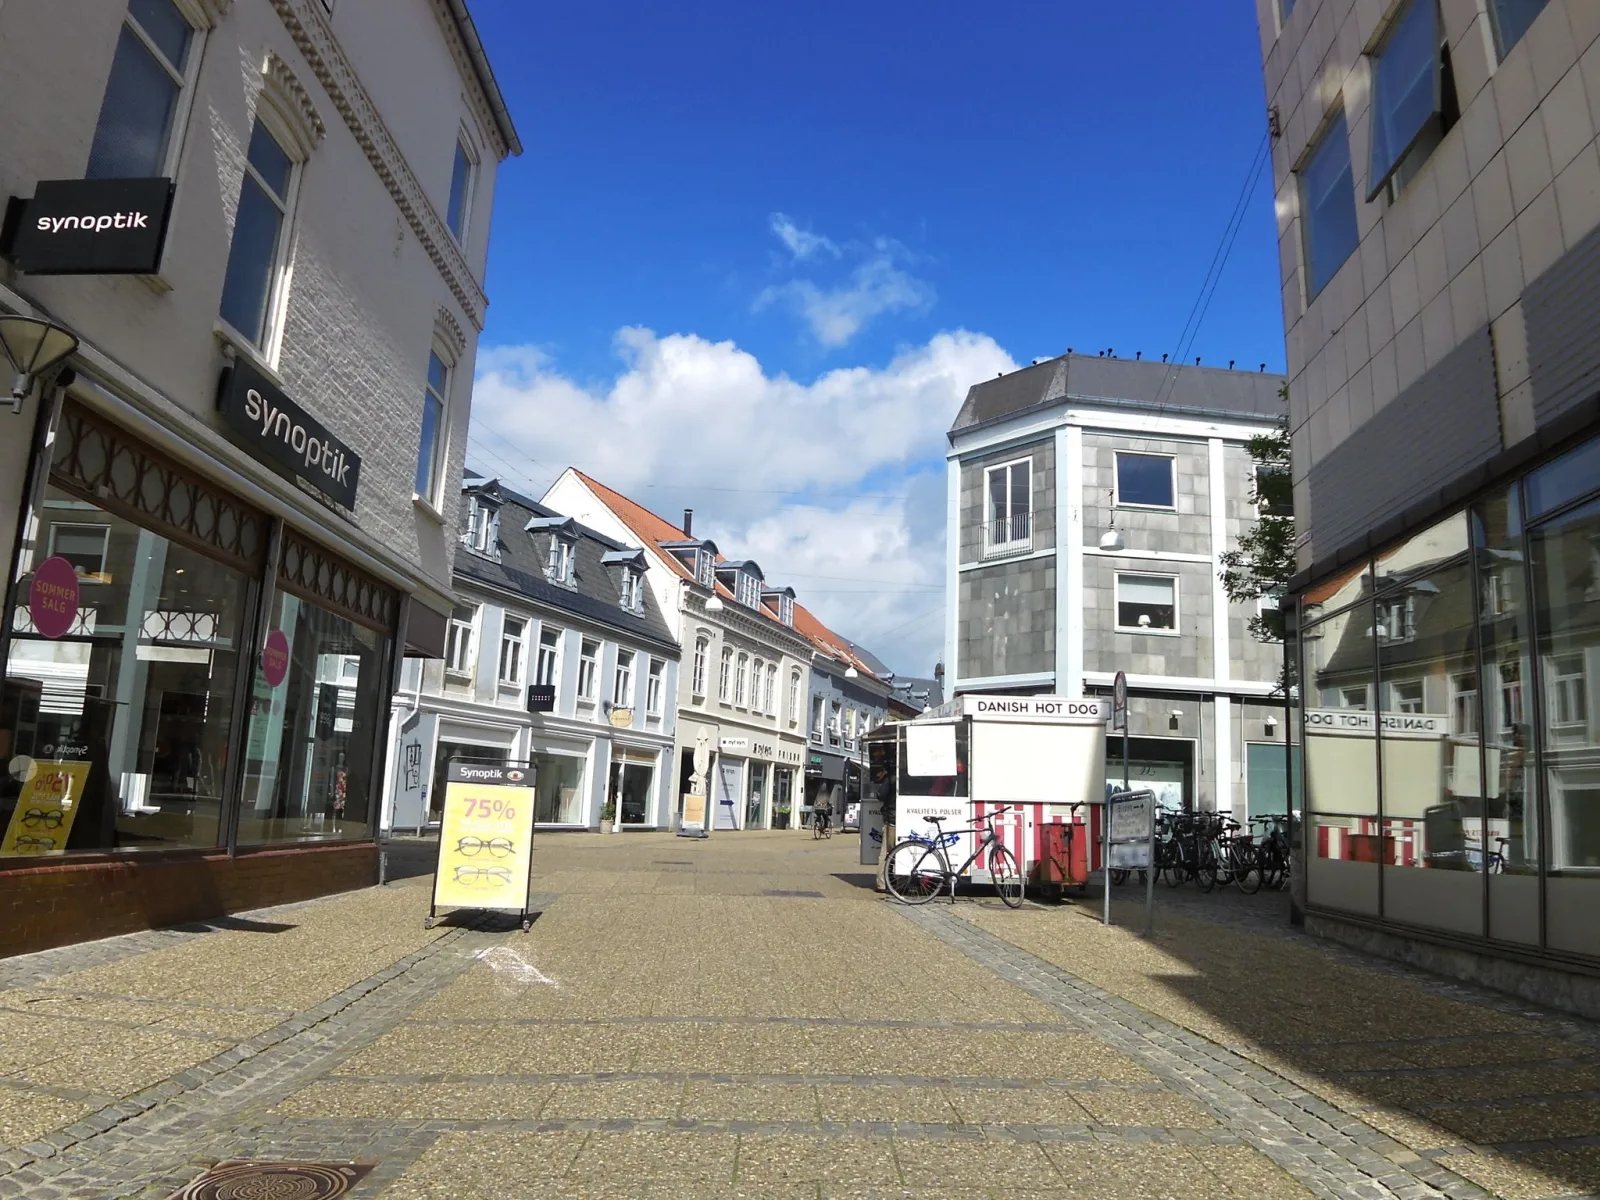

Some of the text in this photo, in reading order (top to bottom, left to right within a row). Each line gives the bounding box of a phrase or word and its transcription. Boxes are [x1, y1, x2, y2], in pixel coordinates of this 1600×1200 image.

[37, 212, 148, 233] synoptik
[245, 389, 350, 488] synoptik
[35, 580, 76, 601] SOMMER
[42, 597, 66, 613] SALG
[978, 701, 1098, 715] DANISH HOT DOG
[460, 767, 502, 779] Synoptik
[464, 798, 516, 820] 75%
